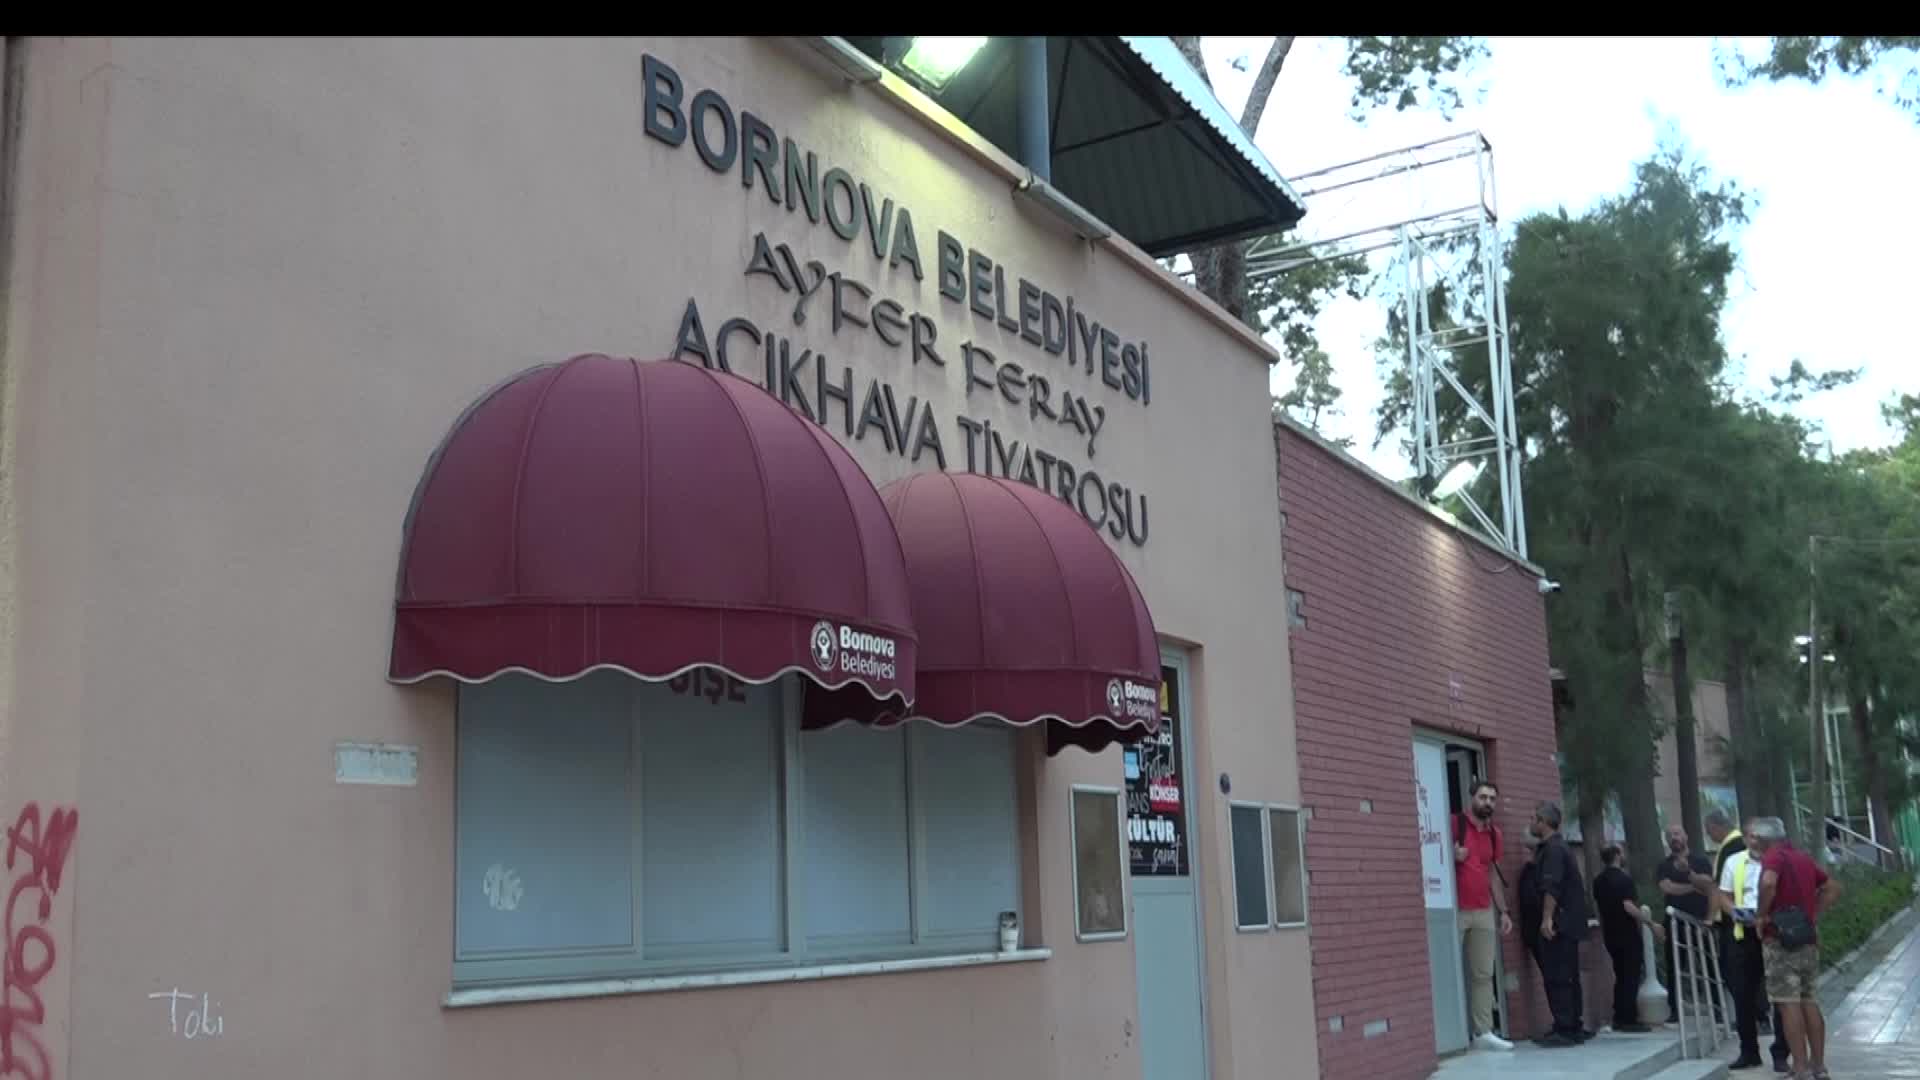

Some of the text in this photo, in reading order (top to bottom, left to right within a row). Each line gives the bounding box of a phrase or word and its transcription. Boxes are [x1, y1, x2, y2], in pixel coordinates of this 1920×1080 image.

[641, 53, 1152, 406] BORNOVA BELEDİYESİ
[744, 231, 1106, 460] AYFER FERAY
[956, 415, 1149, 548] TİYATROSU
[839, 625, 896, 657] Bornova
[840, 650, 896, 681] Belediyesi
[1149, 784, 1180, 803] KONSER
